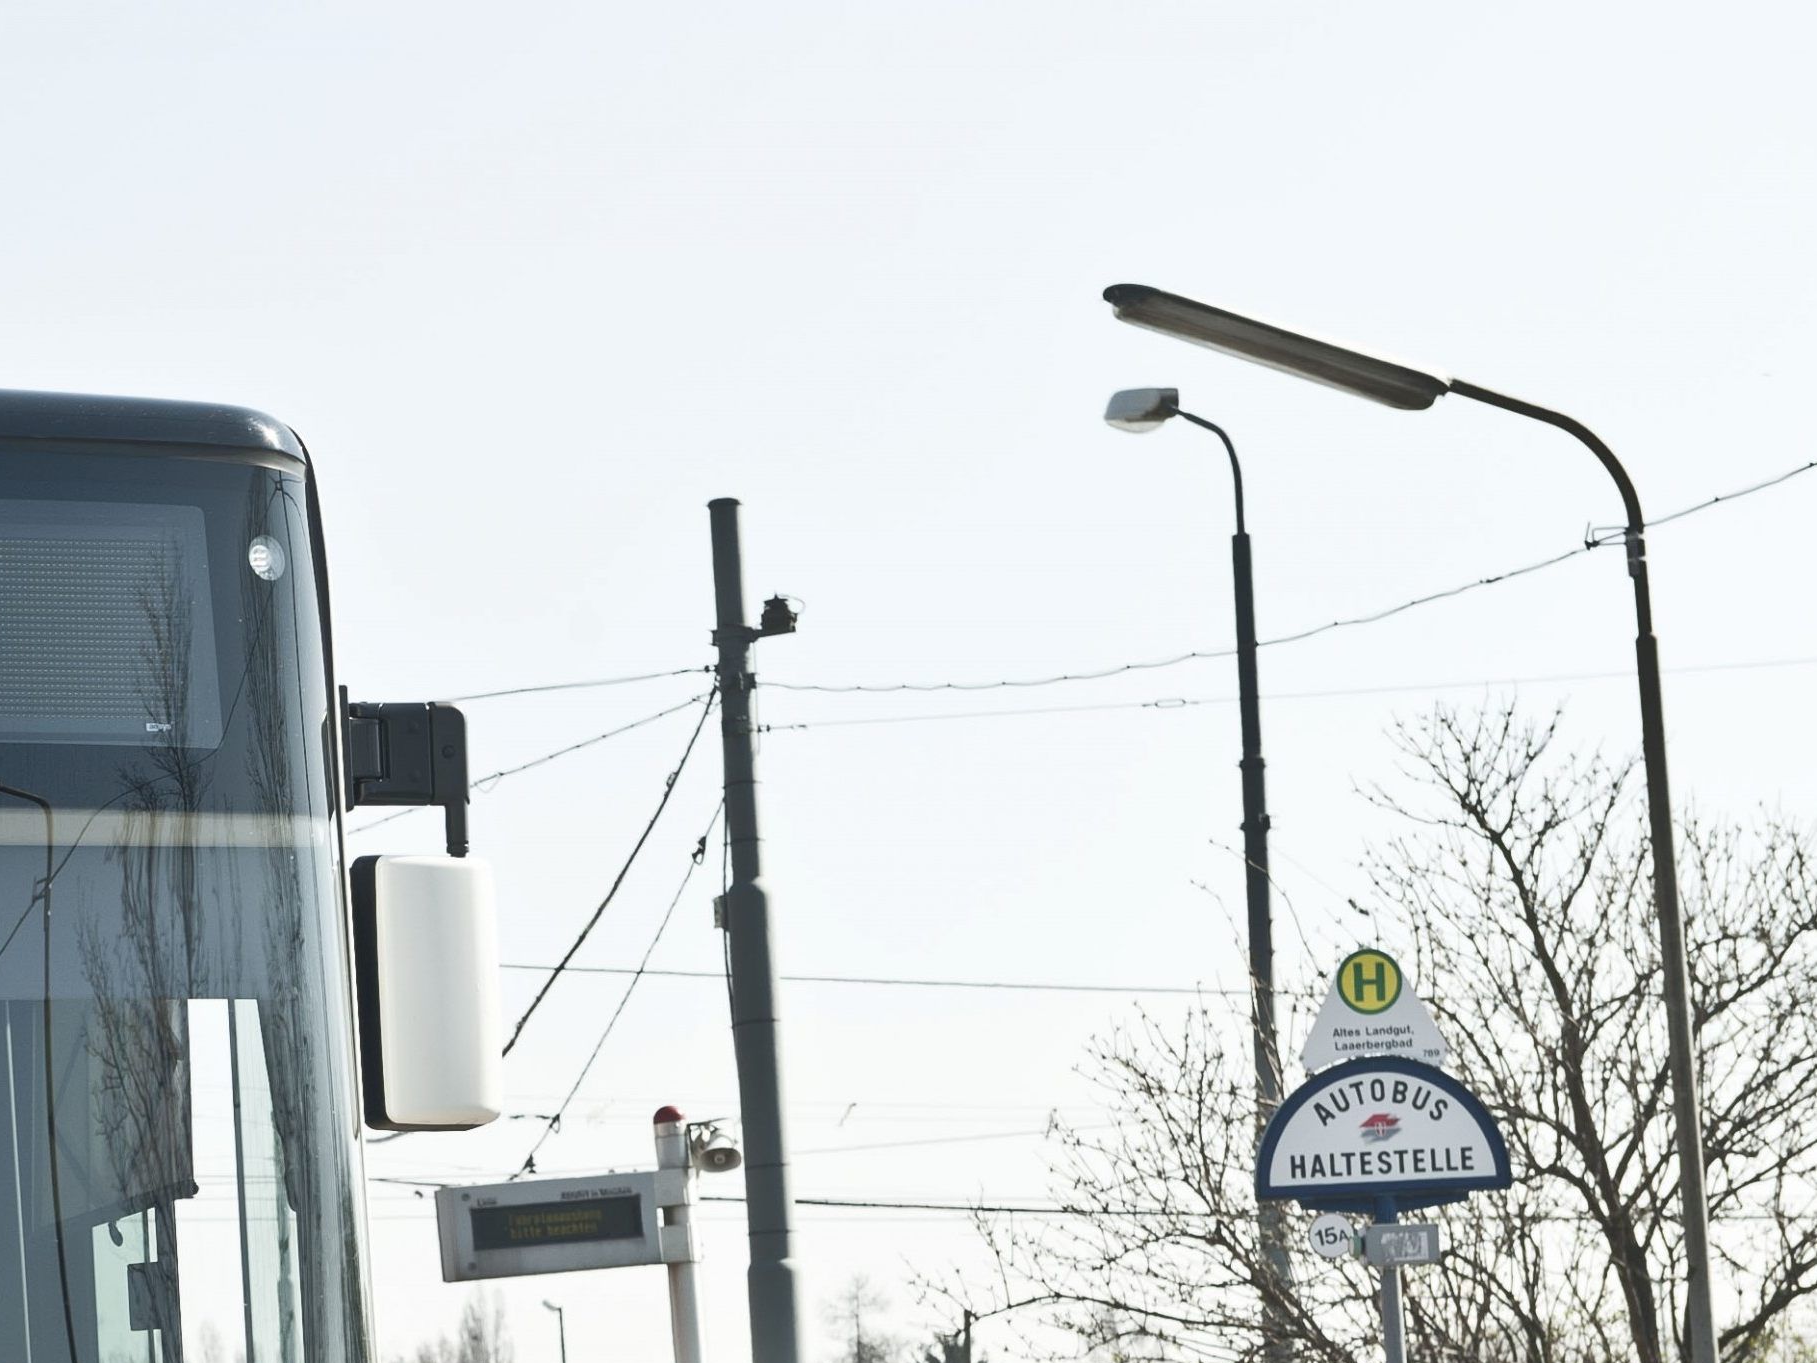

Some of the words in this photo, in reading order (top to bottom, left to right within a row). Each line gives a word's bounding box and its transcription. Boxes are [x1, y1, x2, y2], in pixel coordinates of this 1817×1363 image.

[1353, 962, 1386, 1001] H
[1332, 1027, 1361, 1038] Altes
[1365, 1024, 1414, 1037] Landgut,
[1334, 1038, 1413, 1051] Laaerbergbad
[1313, 1078, 1449, 1126] AUTOBUS
[1290, 1146, 1475, 1179] HALTESTELLE
[1314, 1226, 1350, 1246] 15A
